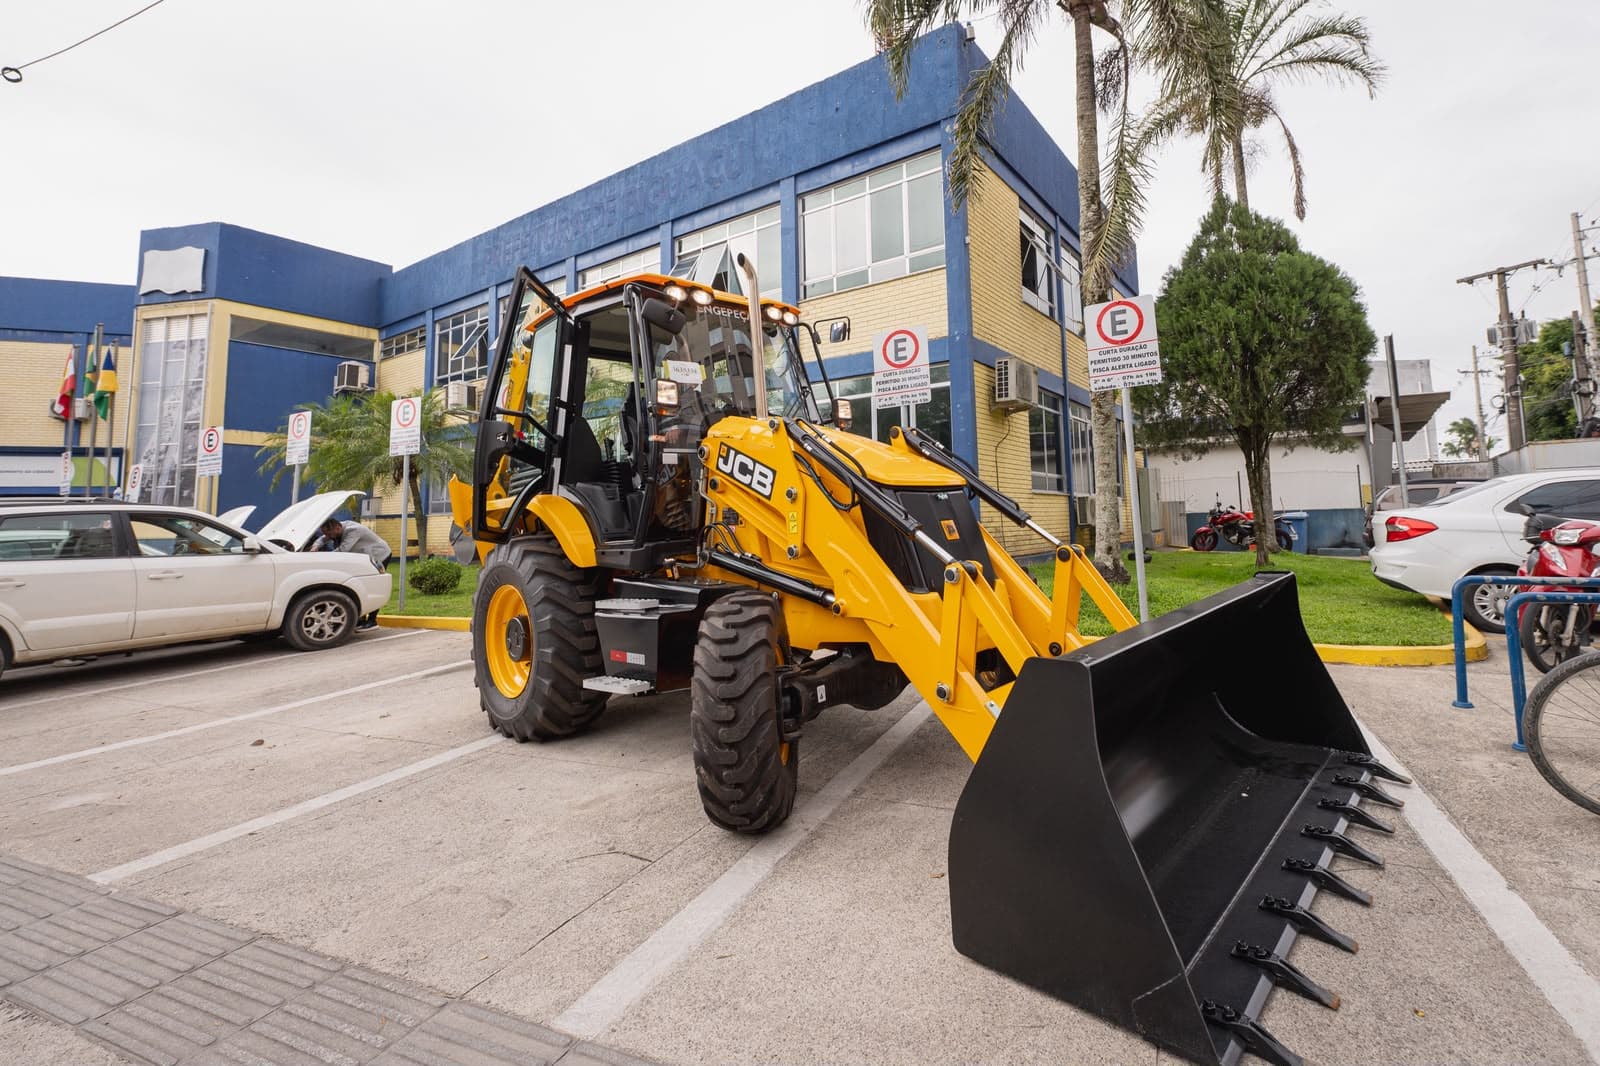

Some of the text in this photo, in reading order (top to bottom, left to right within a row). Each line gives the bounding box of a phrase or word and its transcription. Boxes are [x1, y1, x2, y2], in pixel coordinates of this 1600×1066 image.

[1110, 309, 1128, 336] E
[894, 338, 907, 361] E
[1098, 343, 1148, 356] CURTA DURAÇÃO
[1090, 356, 1122, 366] PERMITIDO
[1130, 351, 1158, 360] MINUTOS
[1092, 359, 1157, 374] PISCA ALERTA LIGADO
[876, 378, 901, 386] PERMITIDO
[402, 404, 410, 421] E
[207, 433, 214, 448] E
[717, 449, 774, 496] JCB
